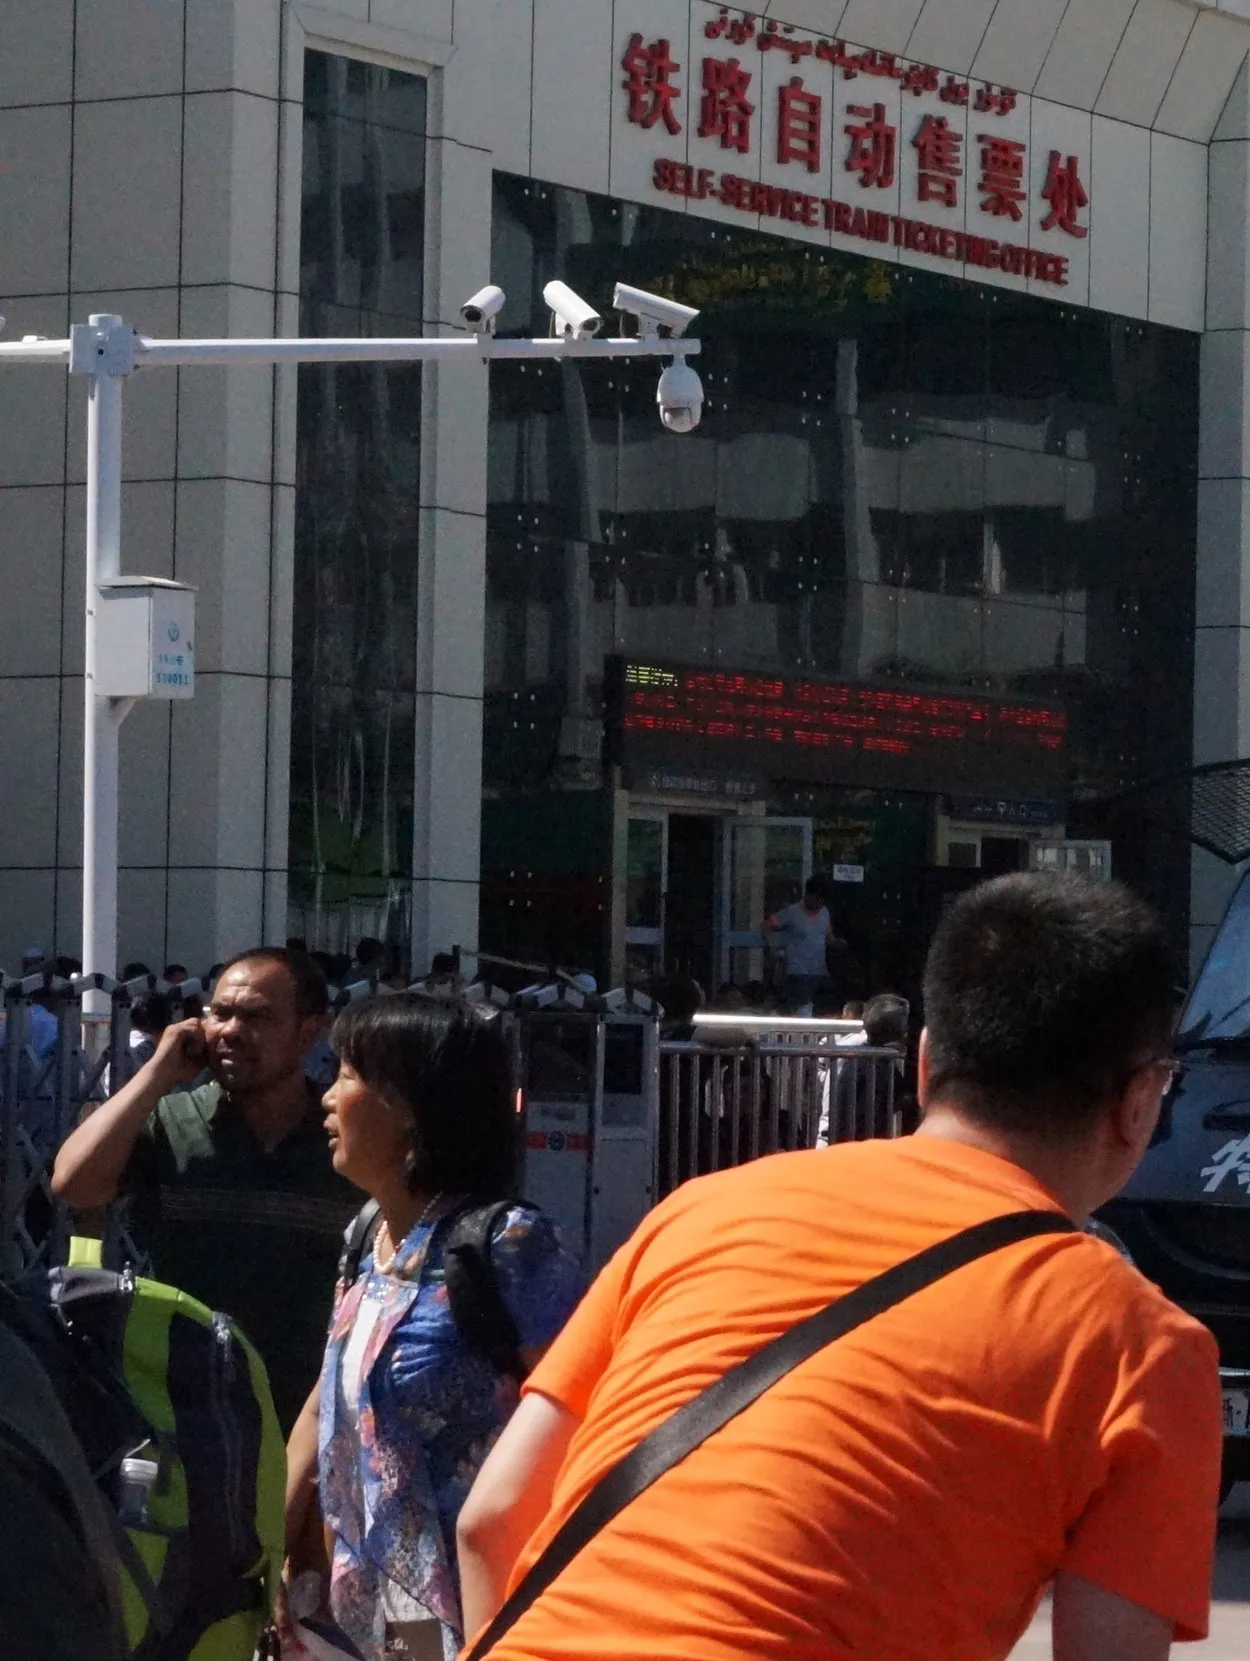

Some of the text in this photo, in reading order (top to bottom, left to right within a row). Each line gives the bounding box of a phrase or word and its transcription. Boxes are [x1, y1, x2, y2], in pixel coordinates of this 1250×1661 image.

[620, 33, 1090, 239] 铁路自动售票处
[653, 157, 1070, 286] SELF-SERVICE TRAIN TICKETING OFFICE
